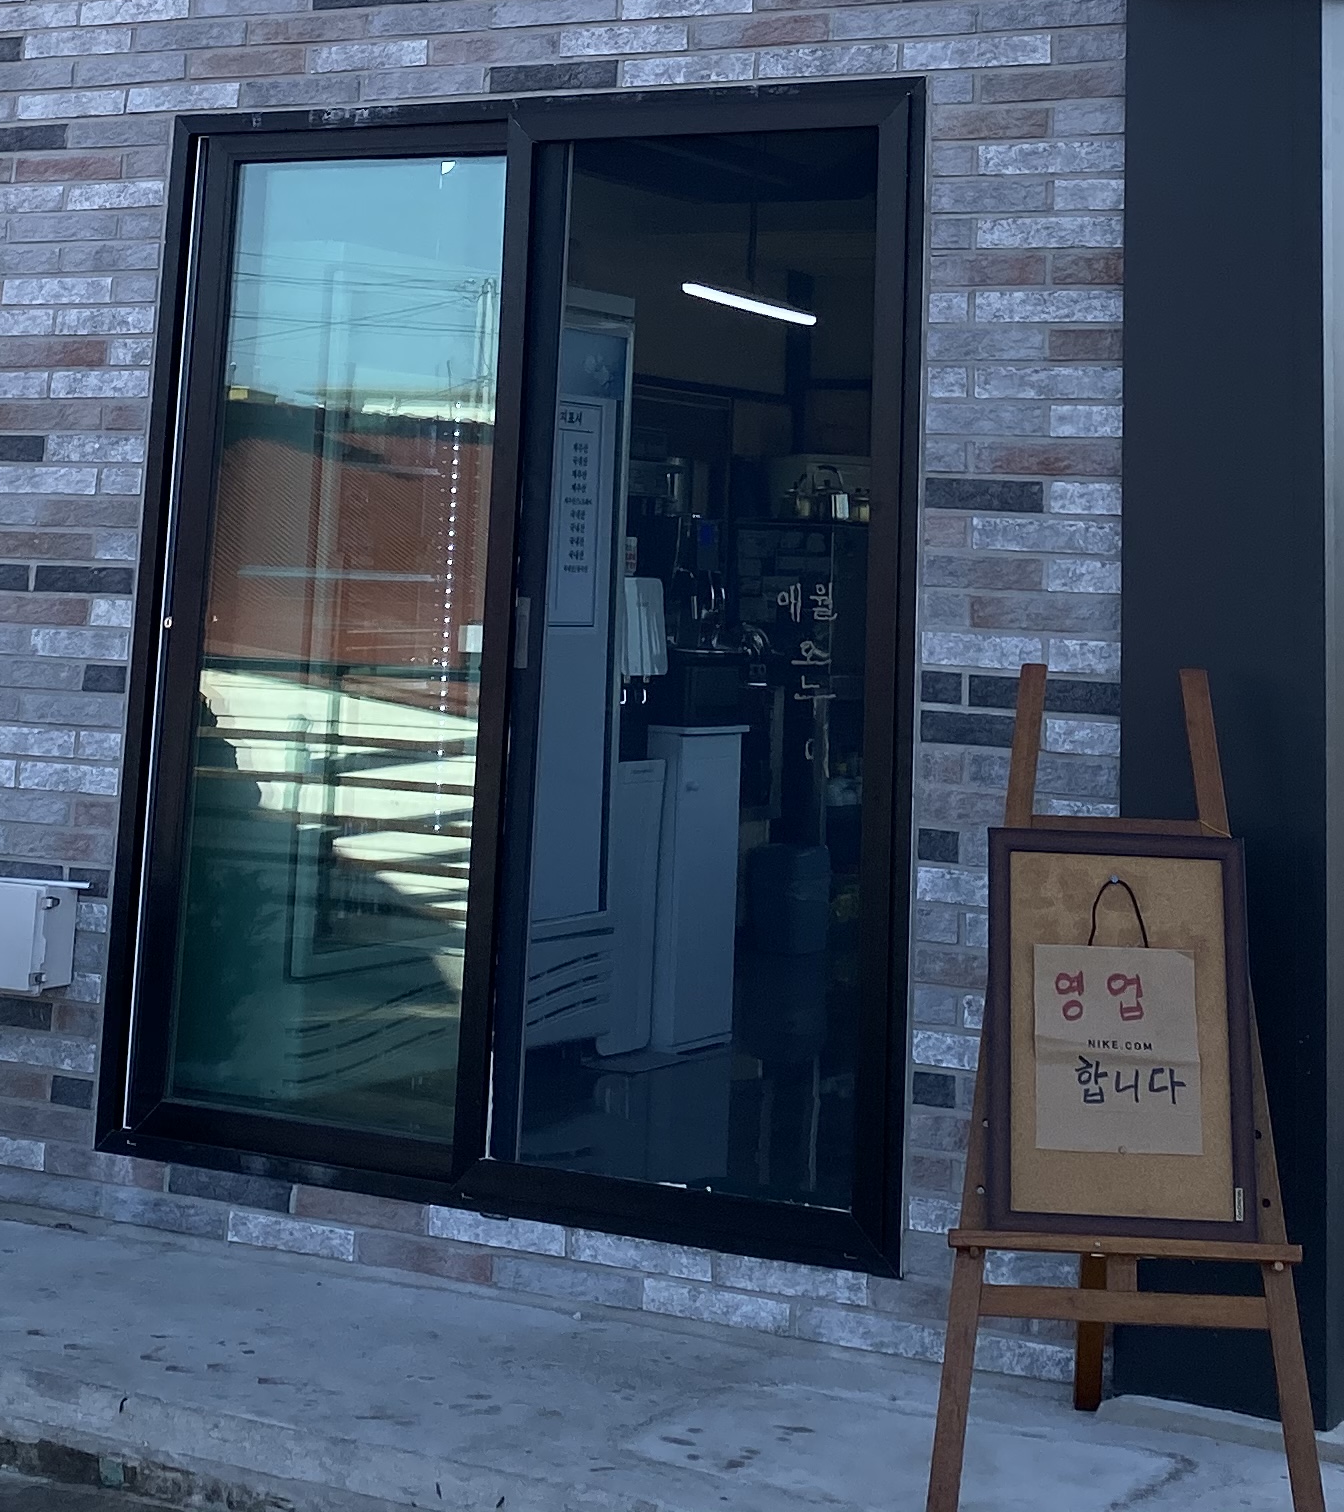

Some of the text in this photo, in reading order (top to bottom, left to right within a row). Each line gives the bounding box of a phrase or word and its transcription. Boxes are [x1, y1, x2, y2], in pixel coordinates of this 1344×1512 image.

[777, 582, 838, 623] 애월
[1054, 971, 1145, 1022] 영업
[1087, 1037, 1154, 1052] NIKE.COM
[1074, 1055, 1187, 1106] 합니다
